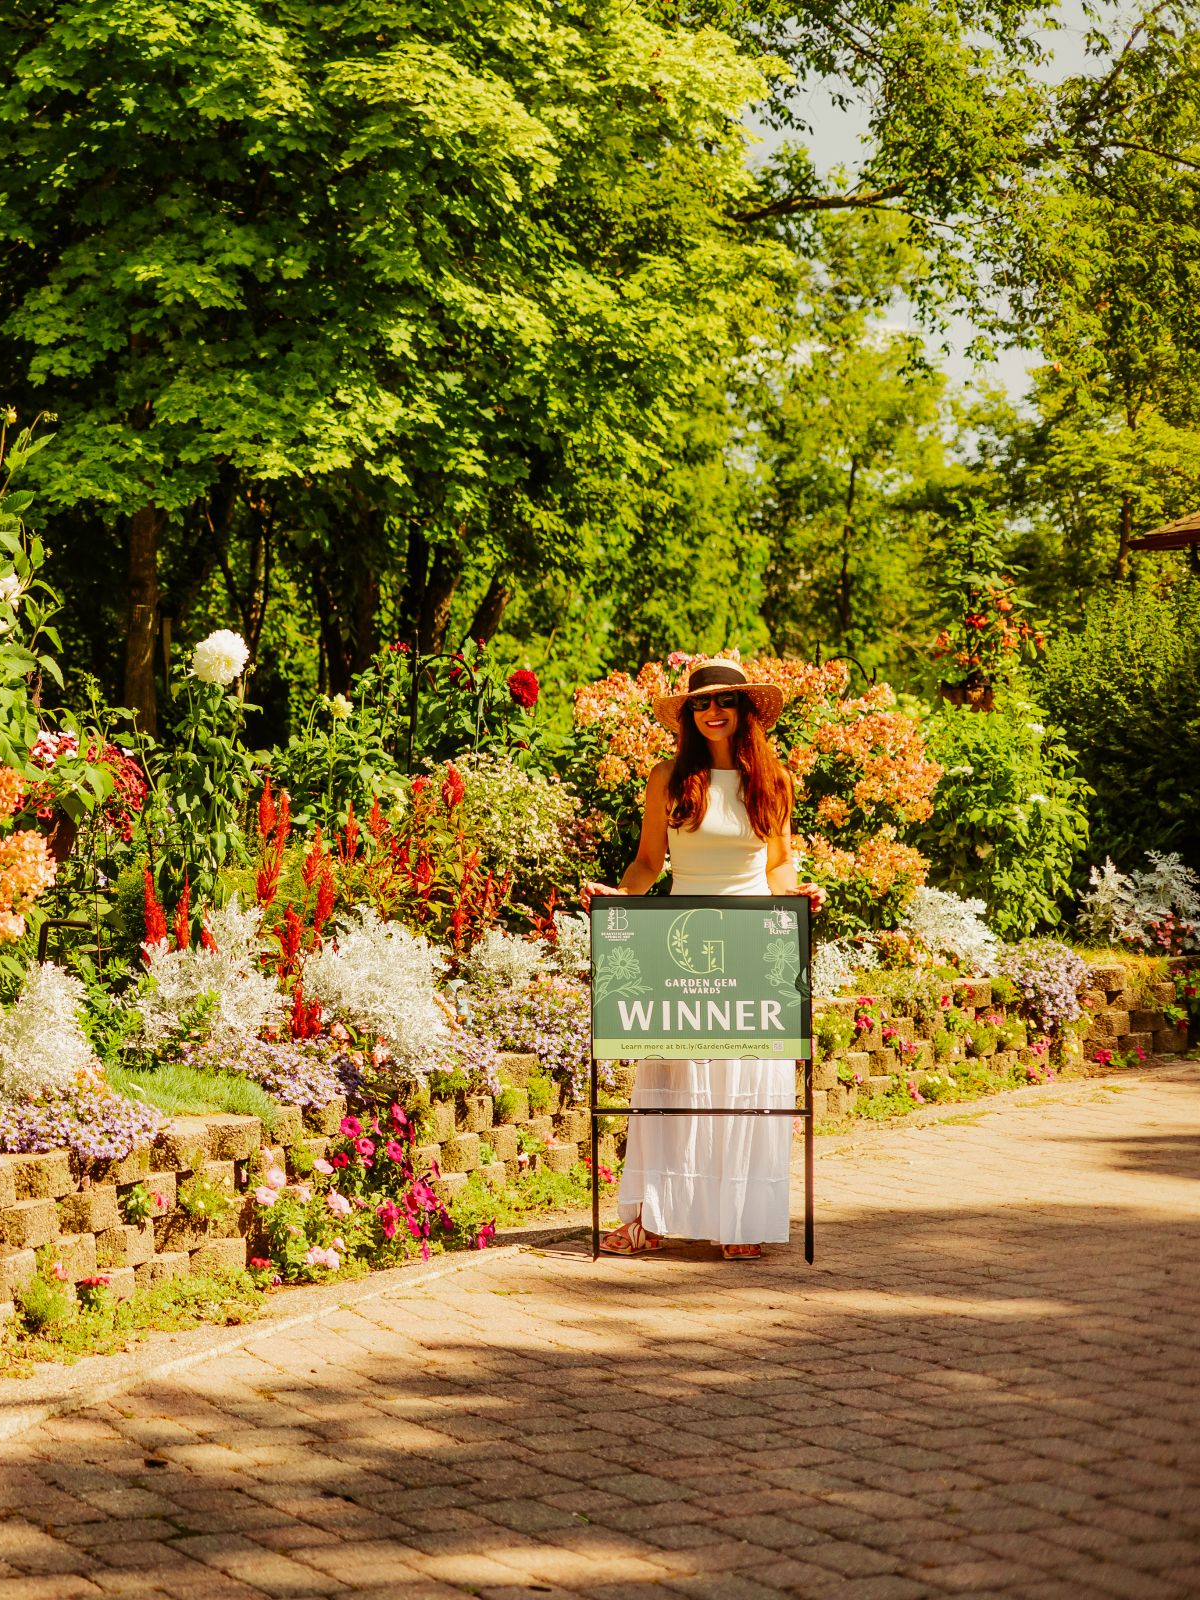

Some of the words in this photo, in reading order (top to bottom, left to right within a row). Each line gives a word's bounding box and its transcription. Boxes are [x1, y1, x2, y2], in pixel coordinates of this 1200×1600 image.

[665, 979, 710, 987] GARDEN
[714, 979, 737, 987] GEM
[617, 1000, 786, 1031] WINNER
[676, 1043, 770, 1051] bit.ly/GardenGemAwards
